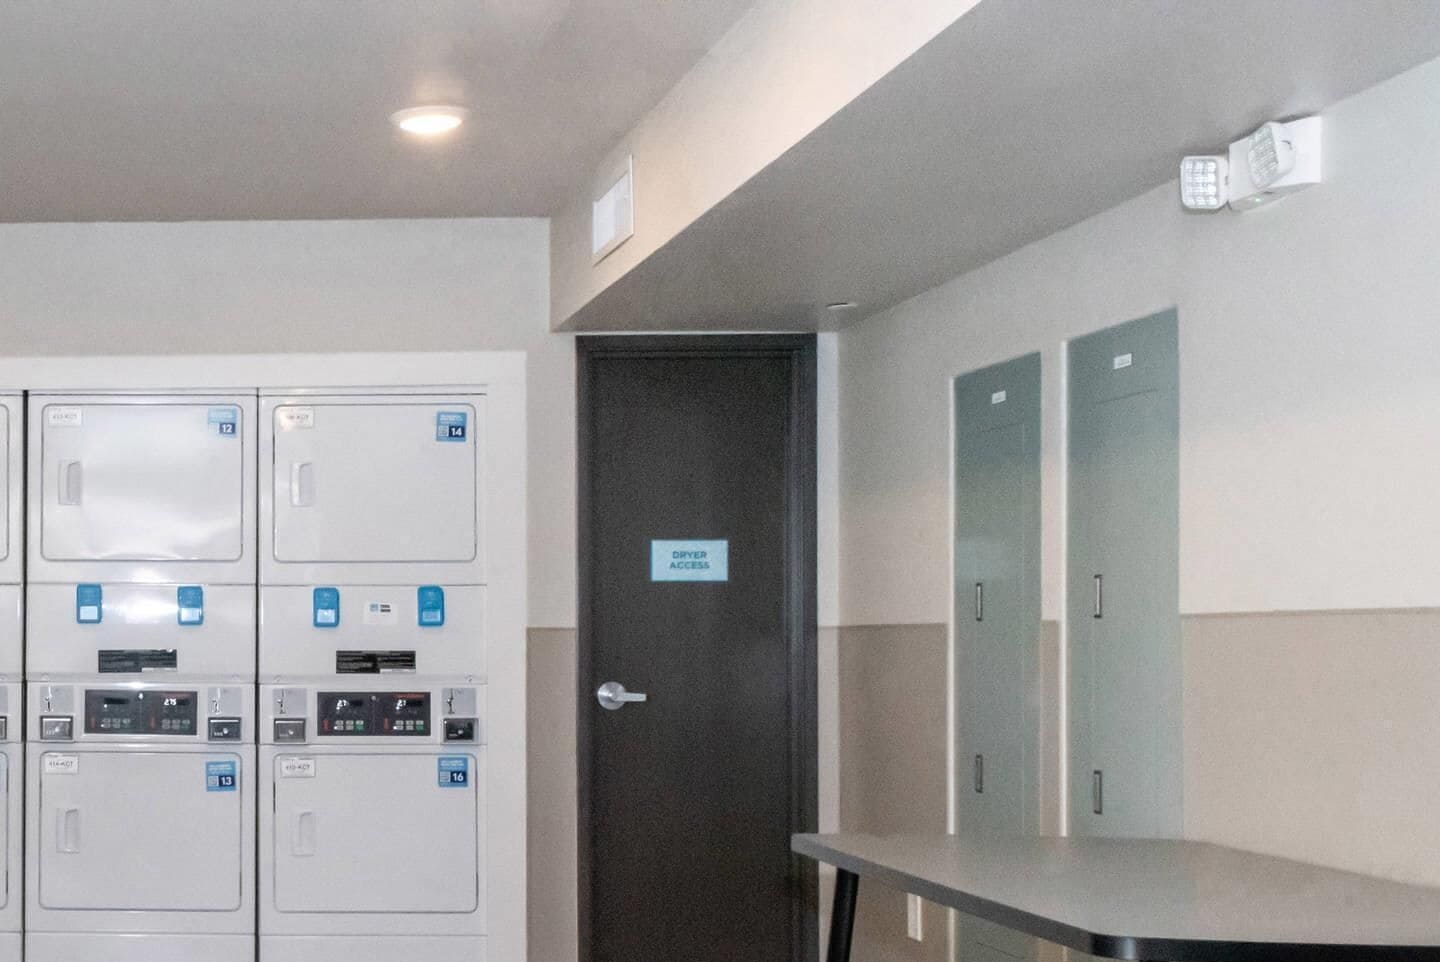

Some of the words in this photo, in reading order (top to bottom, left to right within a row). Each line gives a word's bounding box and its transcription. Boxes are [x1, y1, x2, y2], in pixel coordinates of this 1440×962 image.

[222, 424, 233, 433] 12
[451, 427, 462, 436] 14
[672, 551, 707, 559] DRYER
[670, 561, 710, 569] ACCESS
[221, 776, 232, 785] 13
[452, 773, 463, 782] 16
